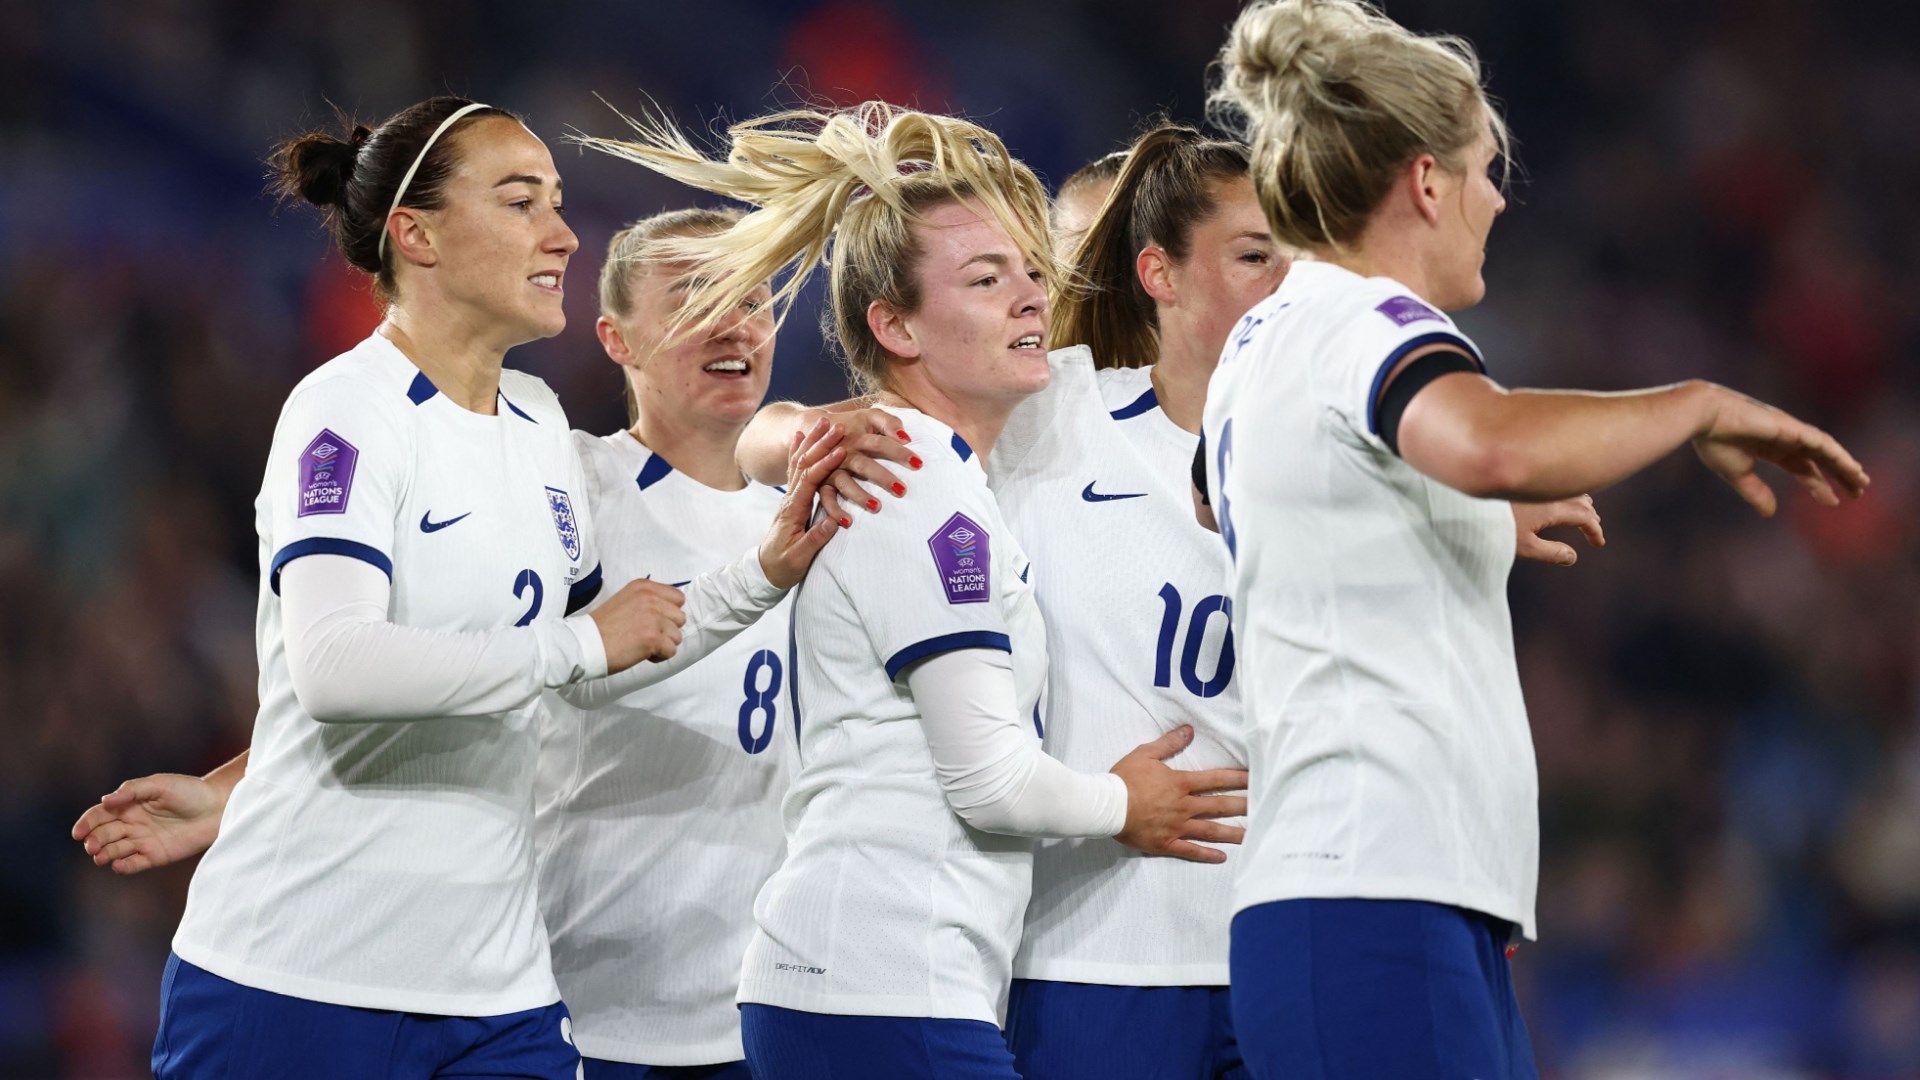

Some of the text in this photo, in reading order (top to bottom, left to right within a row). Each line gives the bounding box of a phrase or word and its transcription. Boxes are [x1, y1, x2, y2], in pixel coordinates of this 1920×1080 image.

[304, 488, 342, 498] NATIONS
[305, 496, 339, 506] LEAGUE
[949, 575, 985, 584] NATIONS
[952, 583, 984, 592] LEAGUE
[512, 568, 544, 628] 2
[1153, 581, 1236, 698] 10
[737, 649, 783, 755] 8
